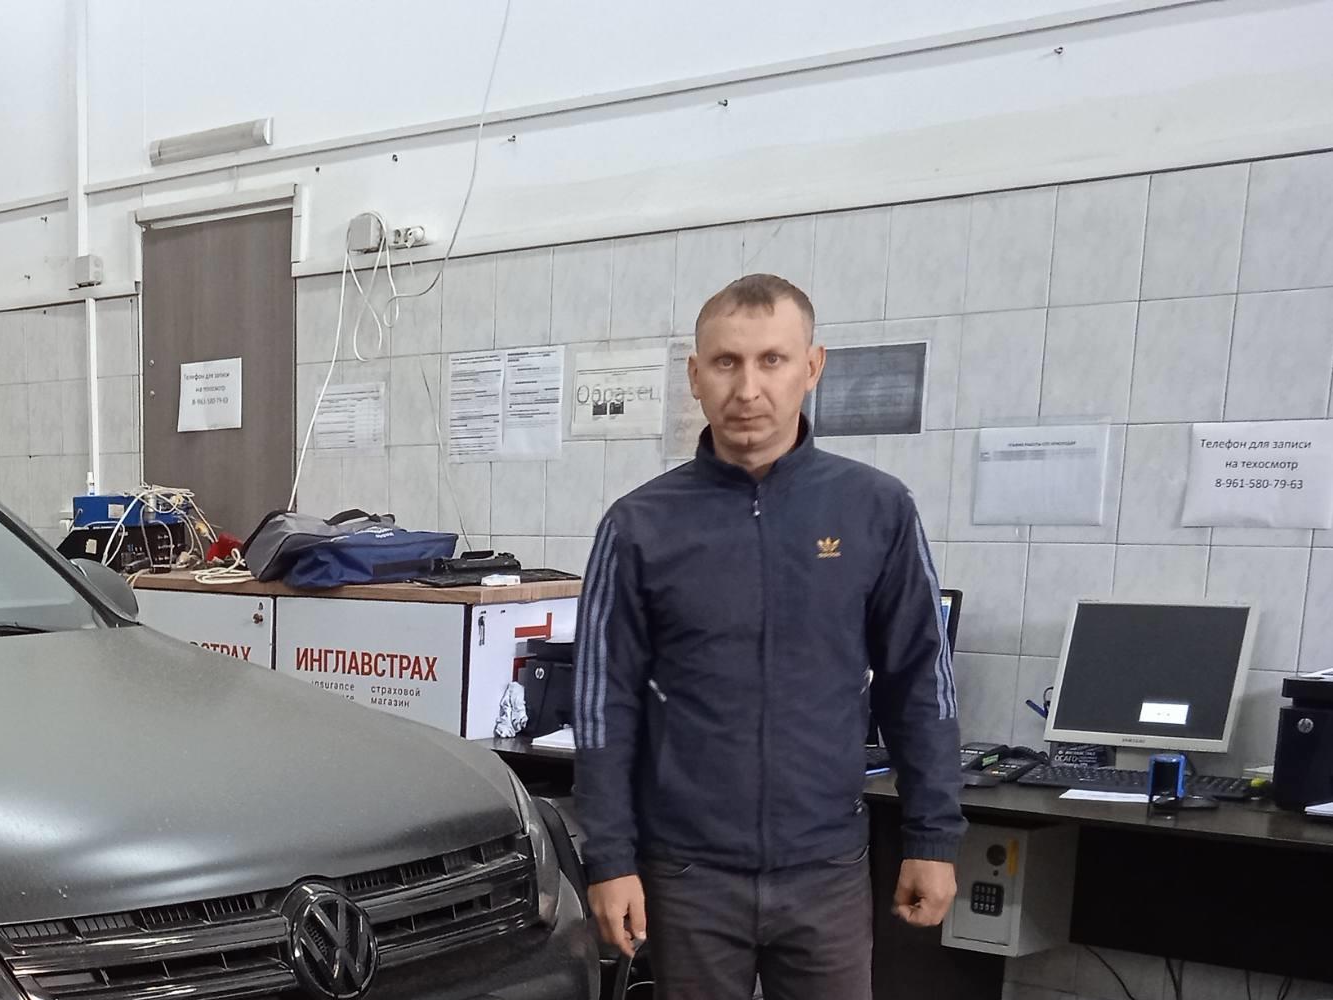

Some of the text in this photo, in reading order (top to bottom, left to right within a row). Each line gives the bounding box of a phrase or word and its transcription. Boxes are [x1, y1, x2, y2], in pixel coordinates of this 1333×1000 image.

[1200, 438, 1312, 451] Телефон для записи
[1225, 460, 1299, 471] на техосмотр
[1214, 478, 1304, 490] 8-961-580-79-63
[295, 647, 438, 682] ИНГЛАВСТРАХ
[370, 685, 422, 697] страховой
[370, 696, 410, 708] магазин
